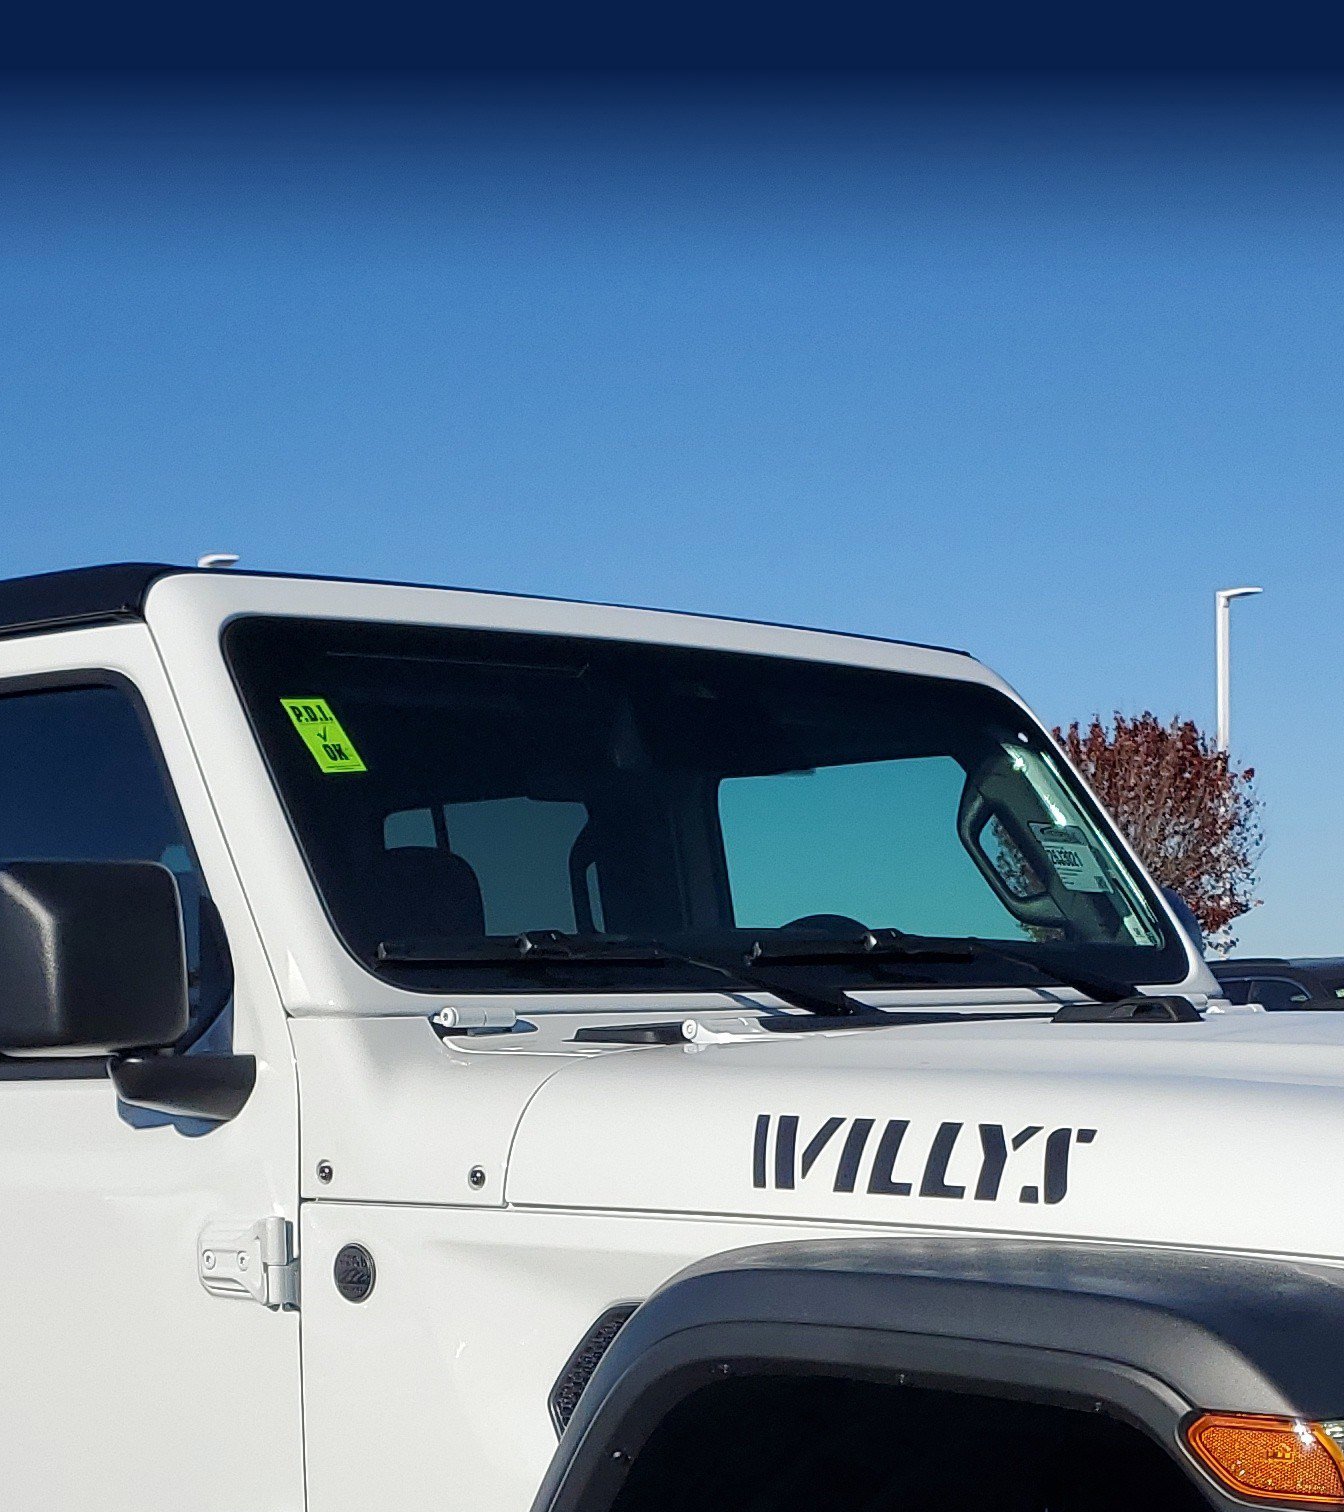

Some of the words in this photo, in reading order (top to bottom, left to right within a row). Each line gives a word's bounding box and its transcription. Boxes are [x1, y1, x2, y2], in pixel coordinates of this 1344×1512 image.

[288, 704, 334, 722] P.D.I.
[321, 743, 351, 762] OK
[752, 1114, 1098, 1205] WILLYS
